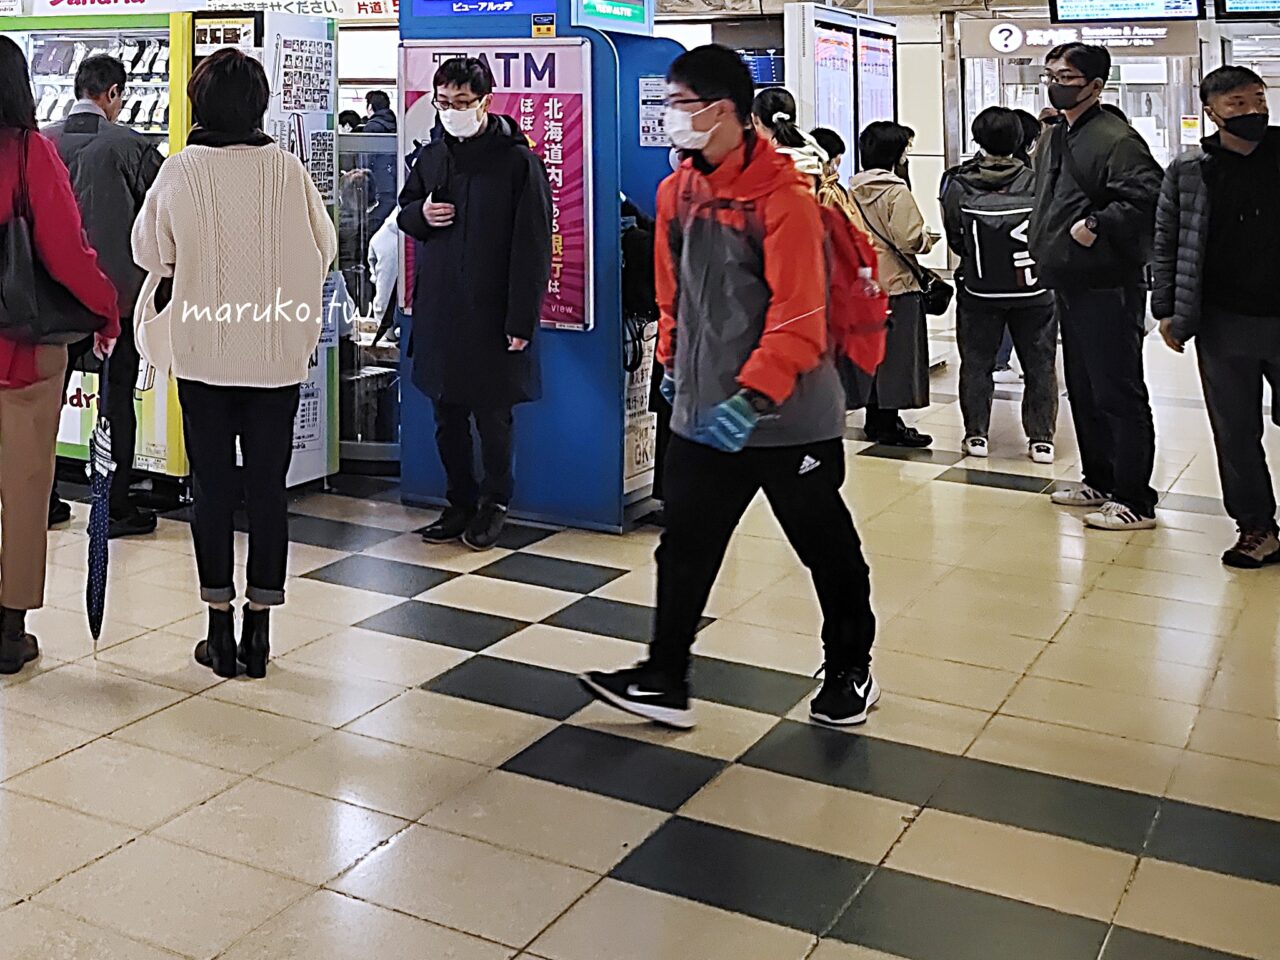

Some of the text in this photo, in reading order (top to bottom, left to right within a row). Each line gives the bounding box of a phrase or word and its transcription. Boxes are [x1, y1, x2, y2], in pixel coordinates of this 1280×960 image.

[357, 0, 383, 14] 片道
[452, 1, 514, 12] ビューアルッテ
